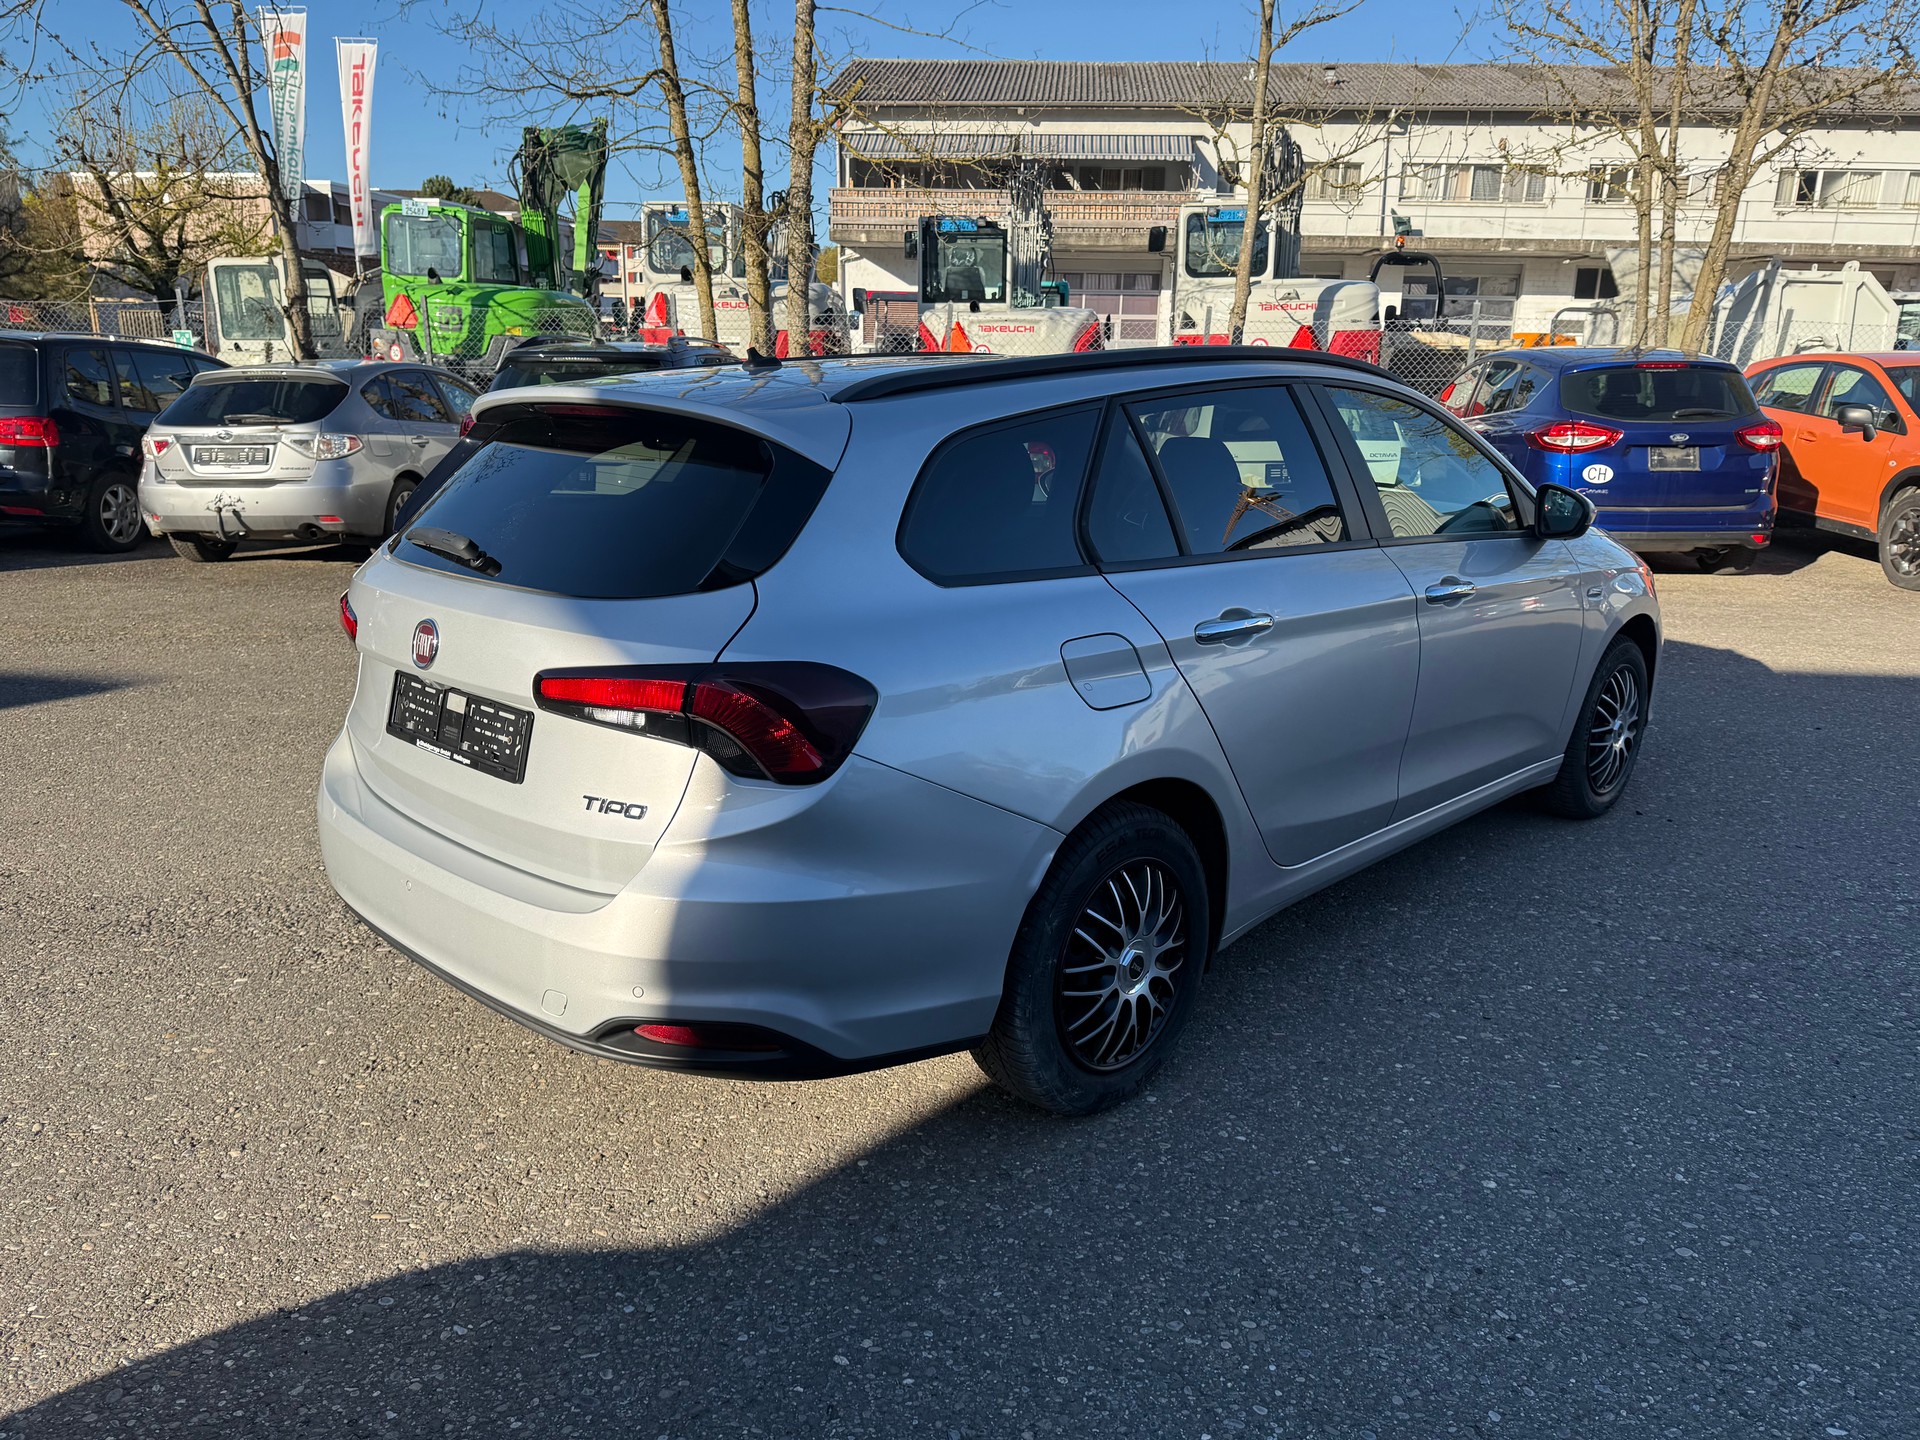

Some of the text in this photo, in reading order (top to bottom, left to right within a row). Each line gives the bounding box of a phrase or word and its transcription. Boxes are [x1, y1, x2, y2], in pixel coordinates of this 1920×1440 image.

[978, 325, 1034, 333] TAKEUCHI
[1587, 467, 1608, 481] CH
[416, 632, 433, 657] FIAT
[582, 794, 648, 820] TIPO
